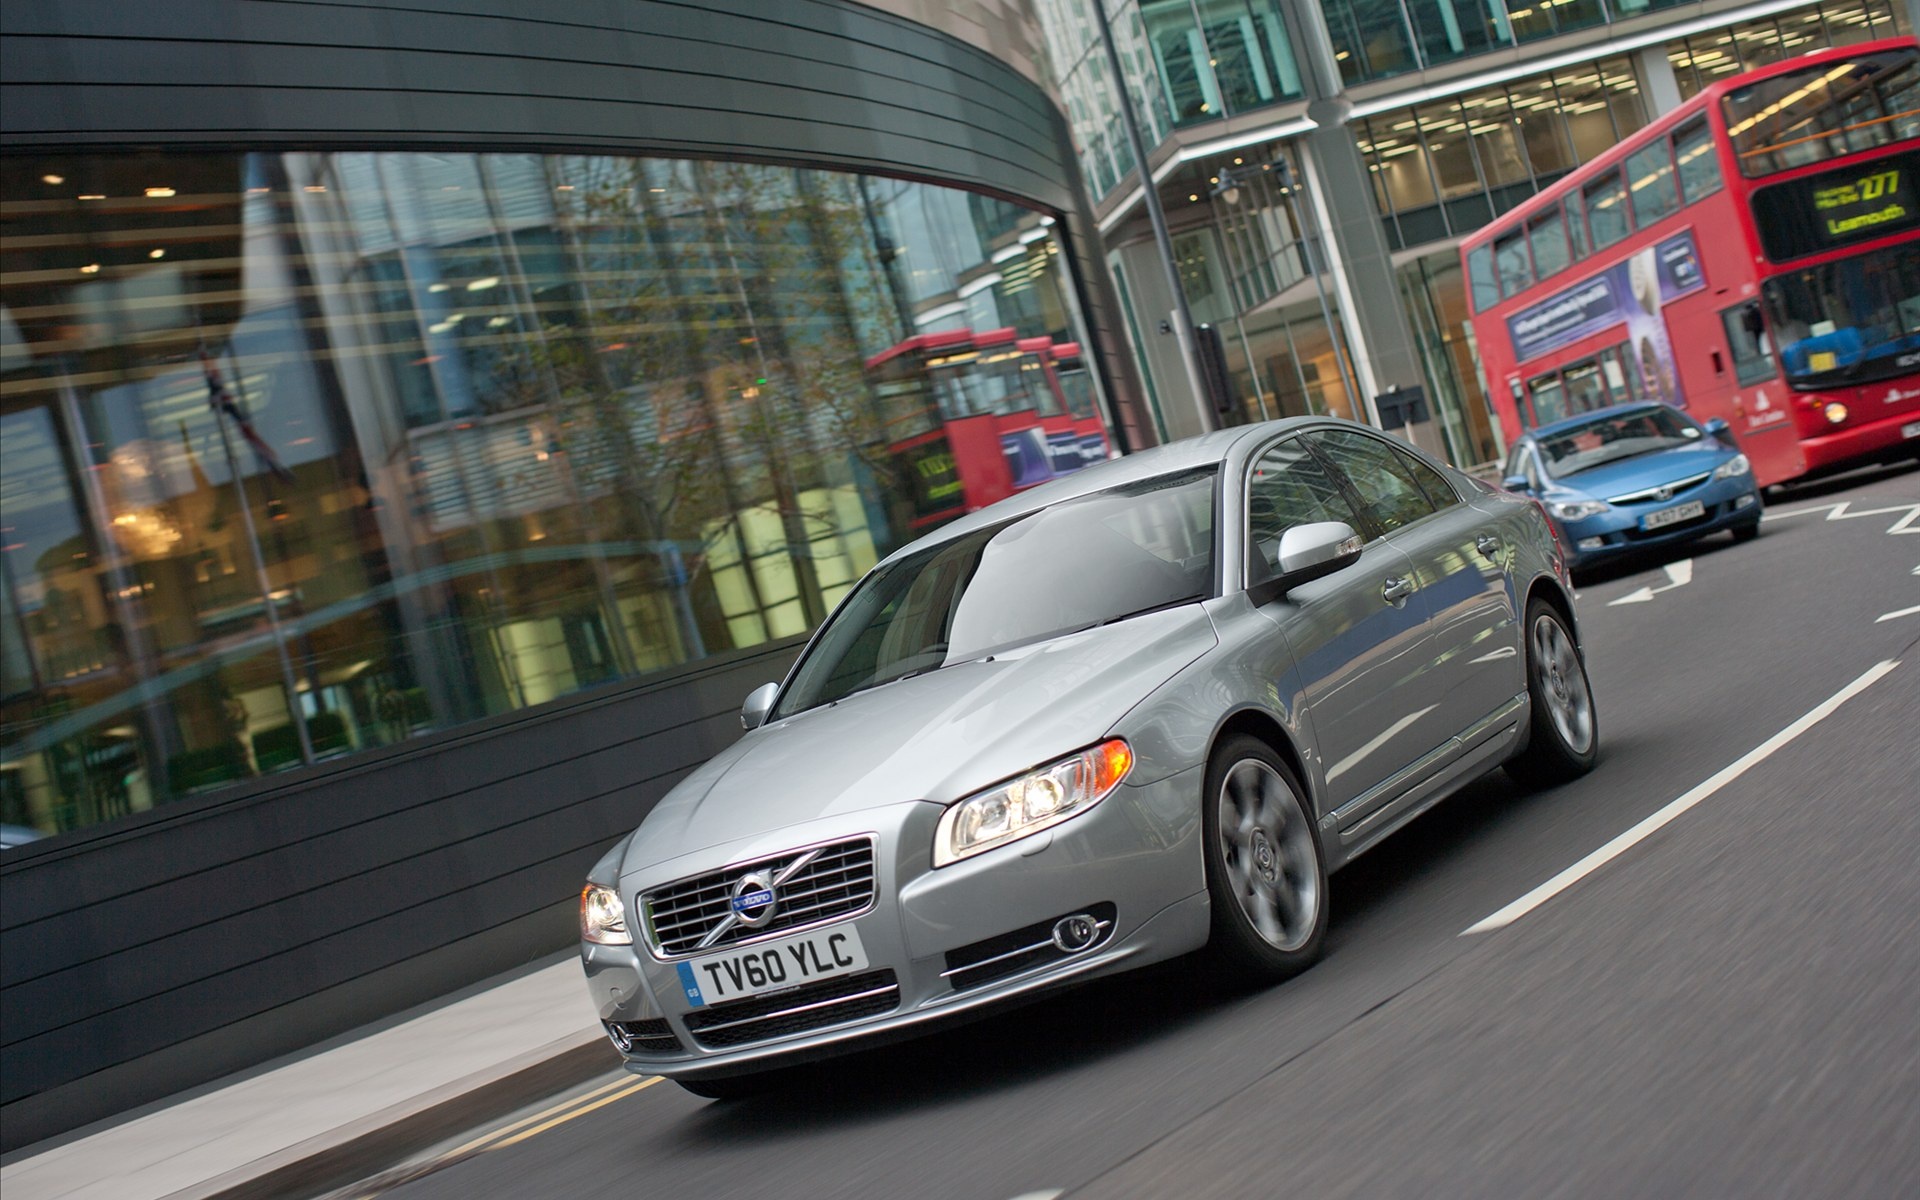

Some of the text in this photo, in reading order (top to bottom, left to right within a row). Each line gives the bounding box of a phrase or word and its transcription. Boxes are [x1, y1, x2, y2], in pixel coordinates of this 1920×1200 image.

[1858, 170, 1899, 201] 277
[1827, 204, 1905, 235] Leamouth
[735, 893, 770, 907] VOLVO
[703, 932, 853, 995] TV60 YLC
[688, 987, 699, 998] GB
